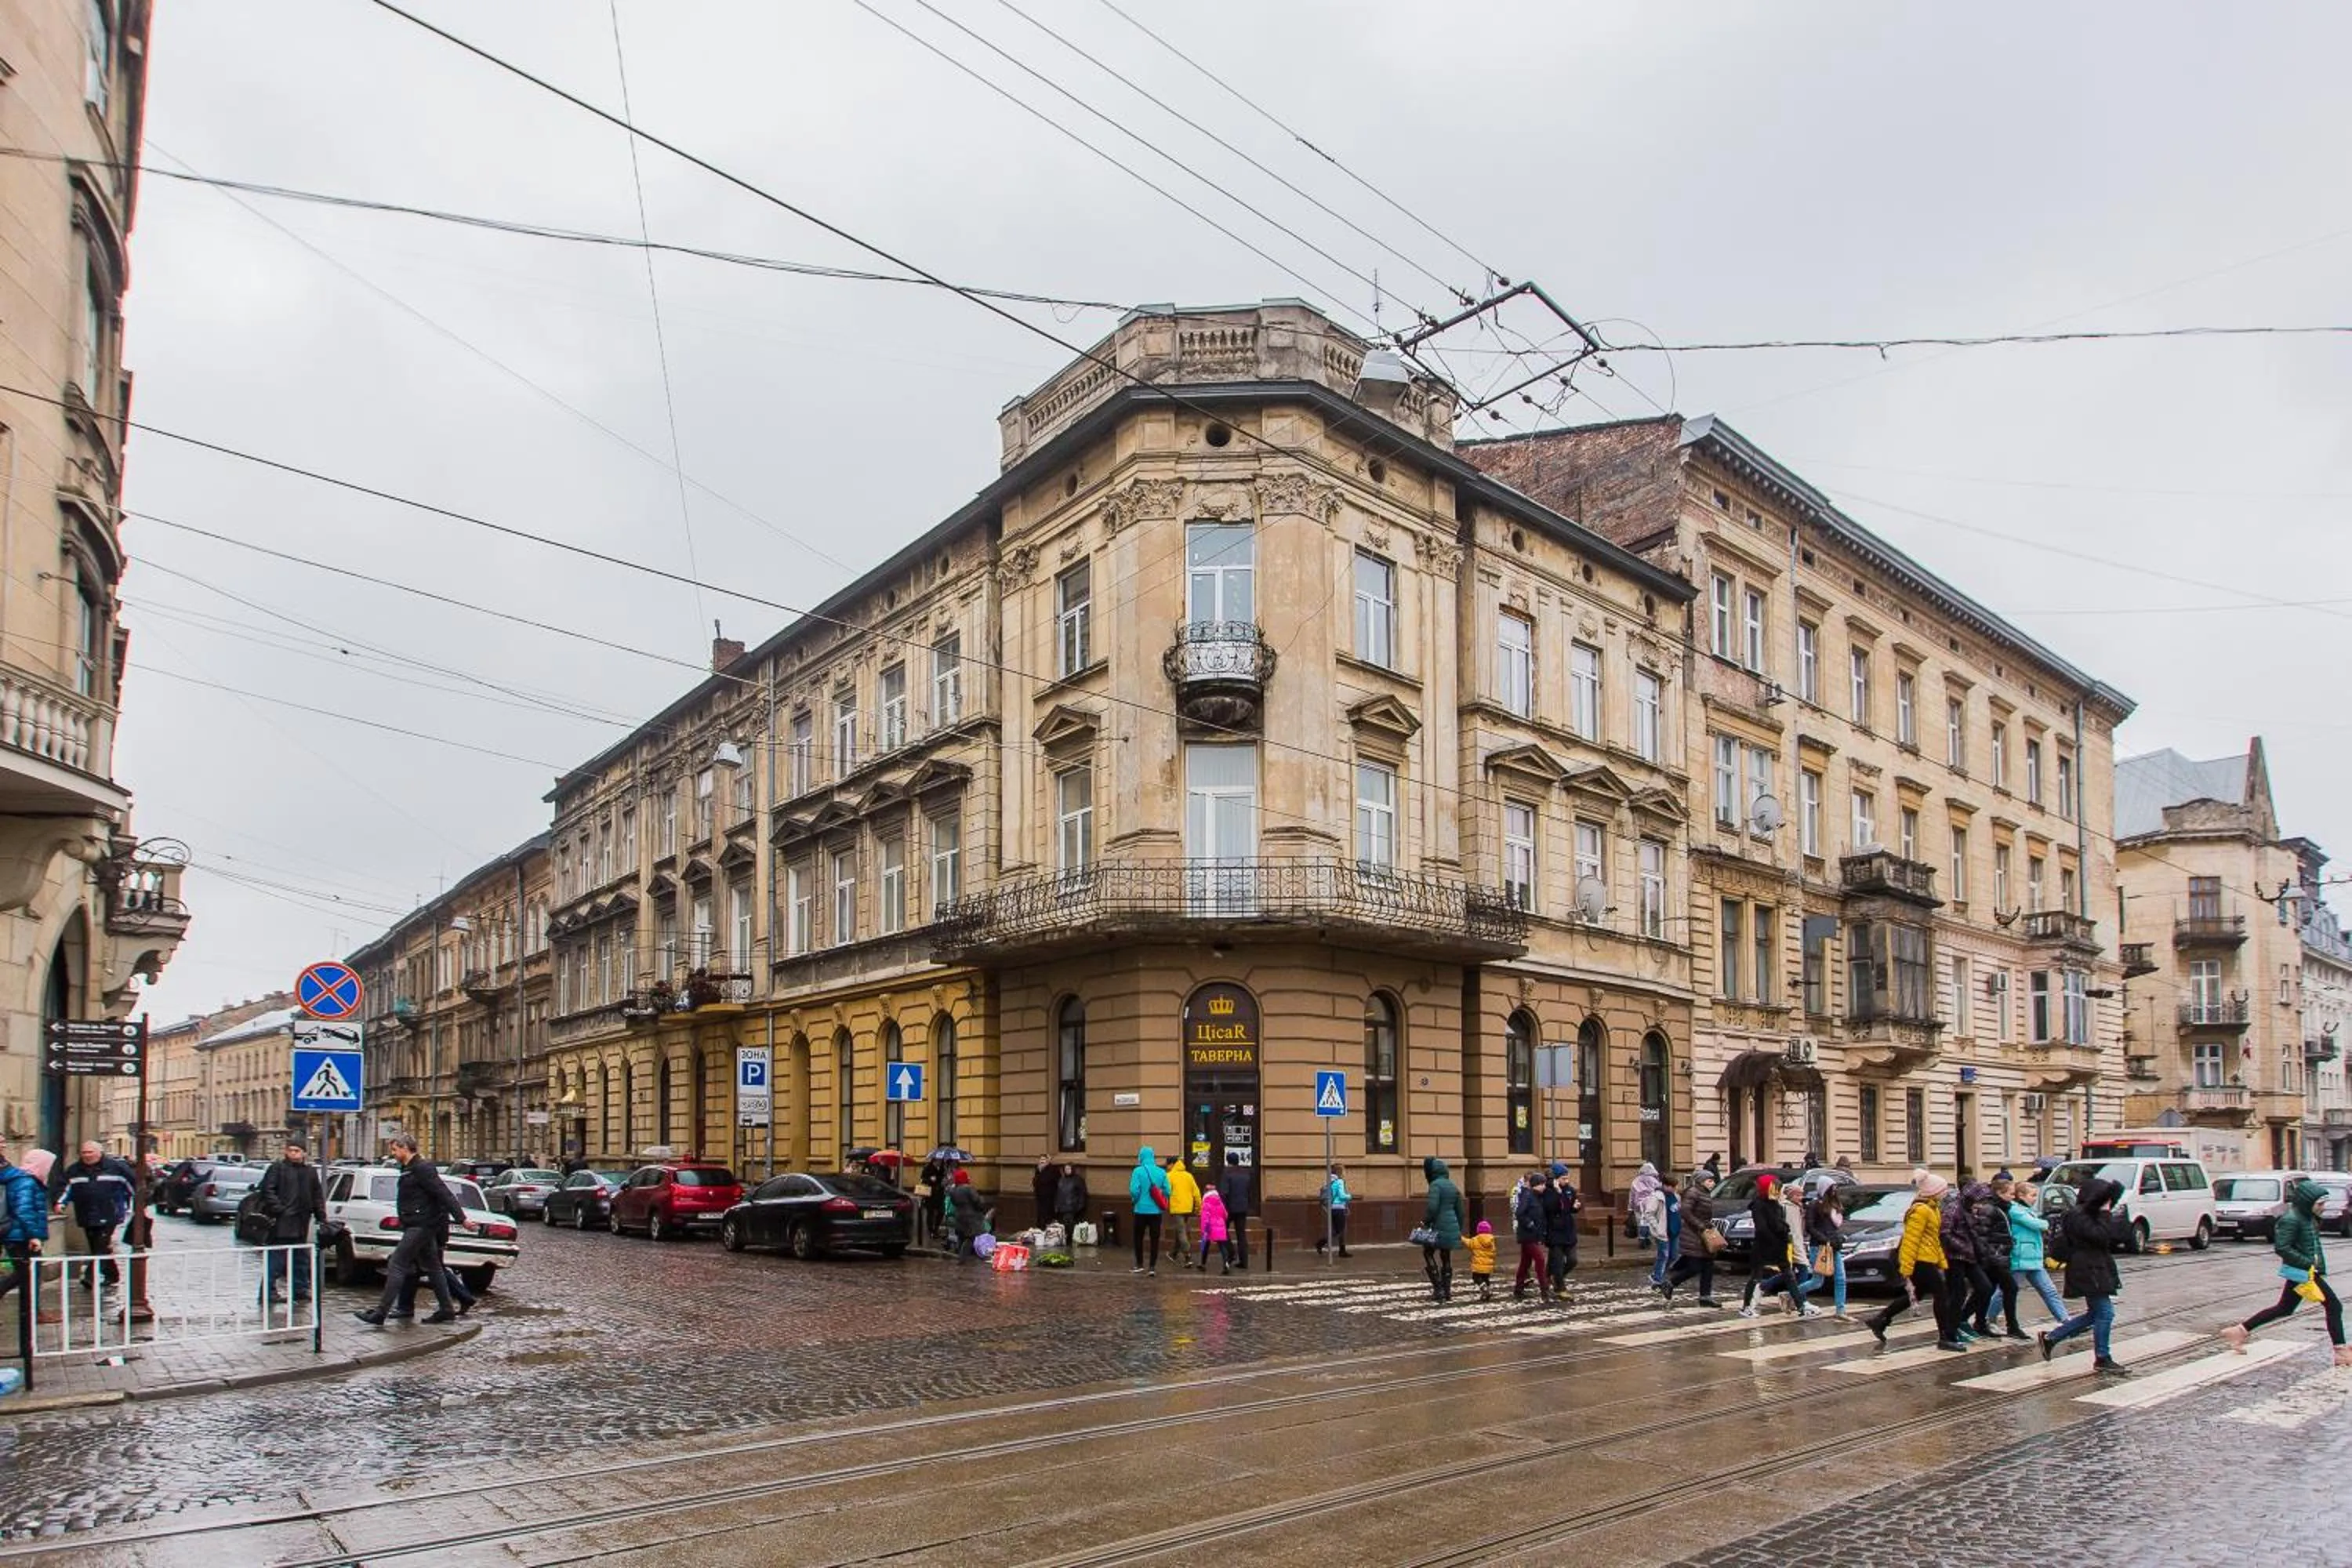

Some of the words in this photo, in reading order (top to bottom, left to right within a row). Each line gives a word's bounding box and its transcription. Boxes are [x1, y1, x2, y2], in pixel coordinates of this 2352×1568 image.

[1197, 1024, 1247, 1041] ЦісаR
[741, 1050, 767, 1059] ЗОНА
[1191, 1050, 1252, 1062] ТАВЕРНА
[747, 1064, 761, 1083] P
